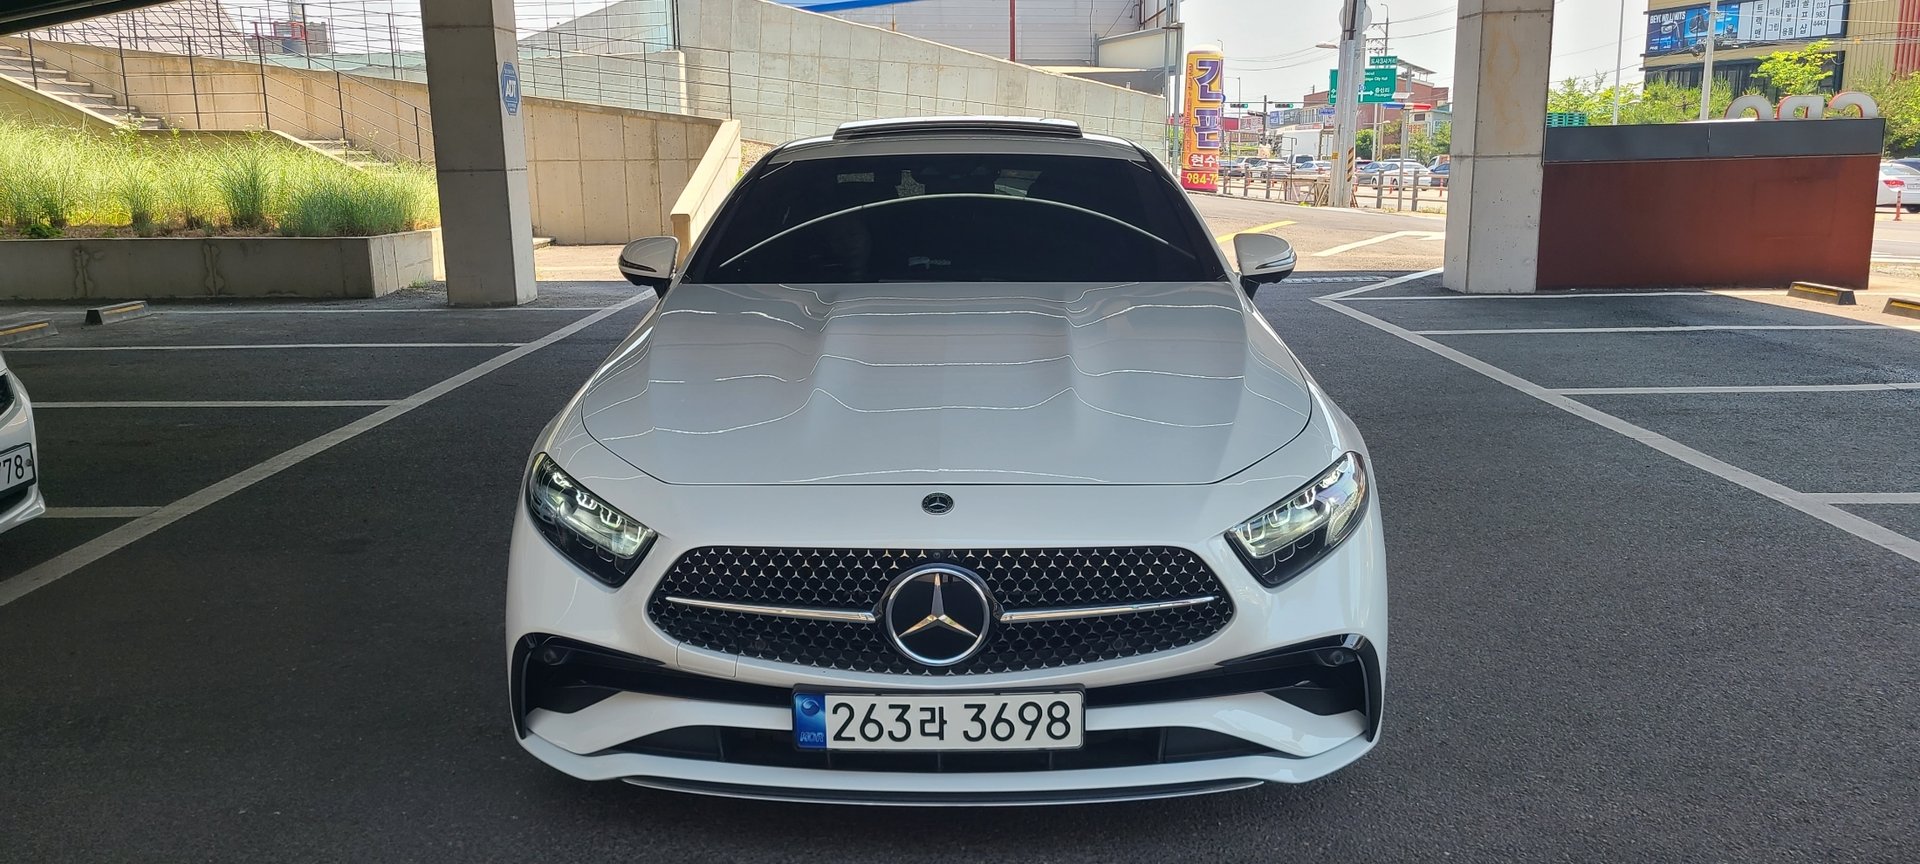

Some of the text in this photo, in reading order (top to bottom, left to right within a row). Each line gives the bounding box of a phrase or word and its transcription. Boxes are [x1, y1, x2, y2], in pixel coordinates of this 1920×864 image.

[1190, 154, 1219, 167] 현수
[0, 454, 24, 485] 78
[831, 700, 1072, 743] 263라 3698
